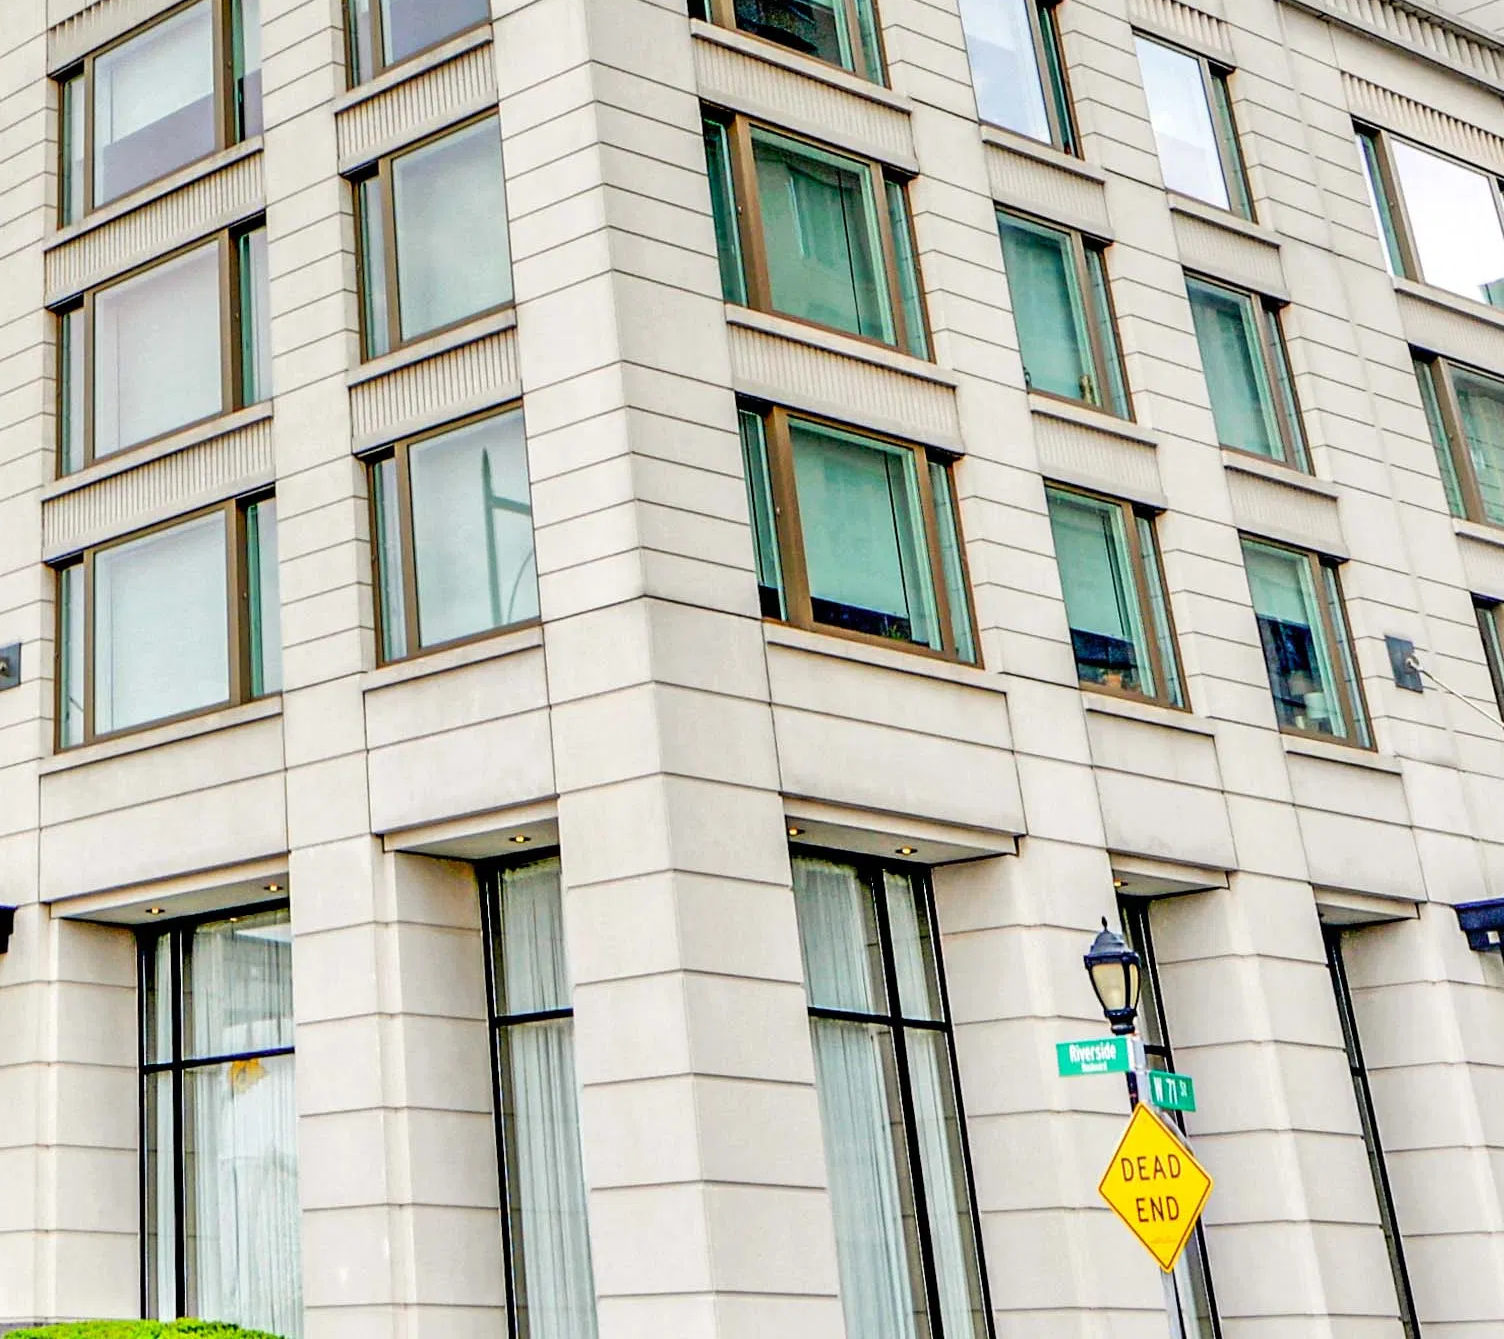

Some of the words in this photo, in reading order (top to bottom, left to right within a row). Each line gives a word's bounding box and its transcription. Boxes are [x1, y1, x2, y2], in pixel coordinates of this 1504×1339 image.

[1068, 1041, 1117, 1063] Riverside
[1153, 1076, 1164, 1102] W
[1166, 1078, 1178, 1106] 71
[1120, 1153, 1181, 1182] DEAD
[1135, 1195, 1179, 1222] END
